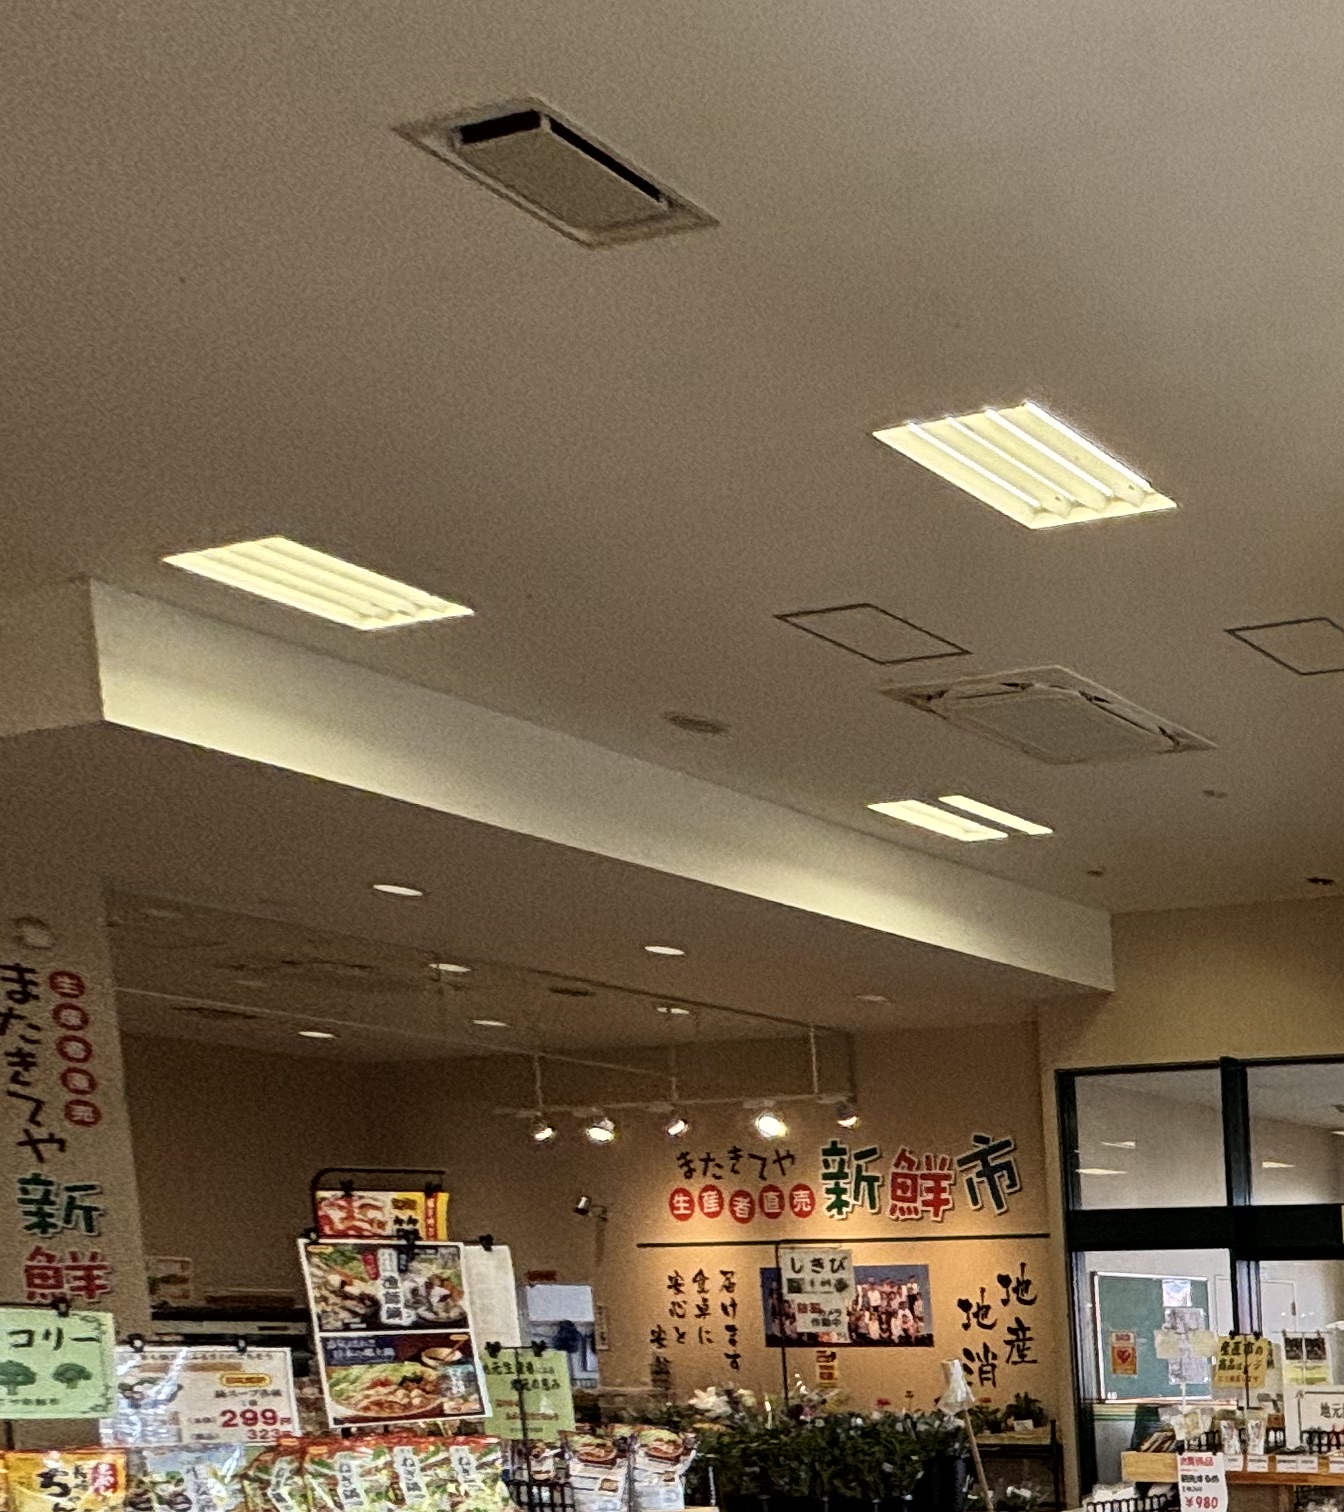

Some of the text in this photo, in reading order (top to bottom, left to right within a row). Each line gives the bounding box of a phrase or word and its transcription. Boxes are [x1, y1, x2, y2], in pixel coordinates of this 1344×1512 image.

[676, 1145, 796, 1181] またきてや
[820, 1133, 1022, 1225] 新鮮市
[670, 1184, 815, 1223] 生産者直売
[7, 1326, 103, 1351] コリー
